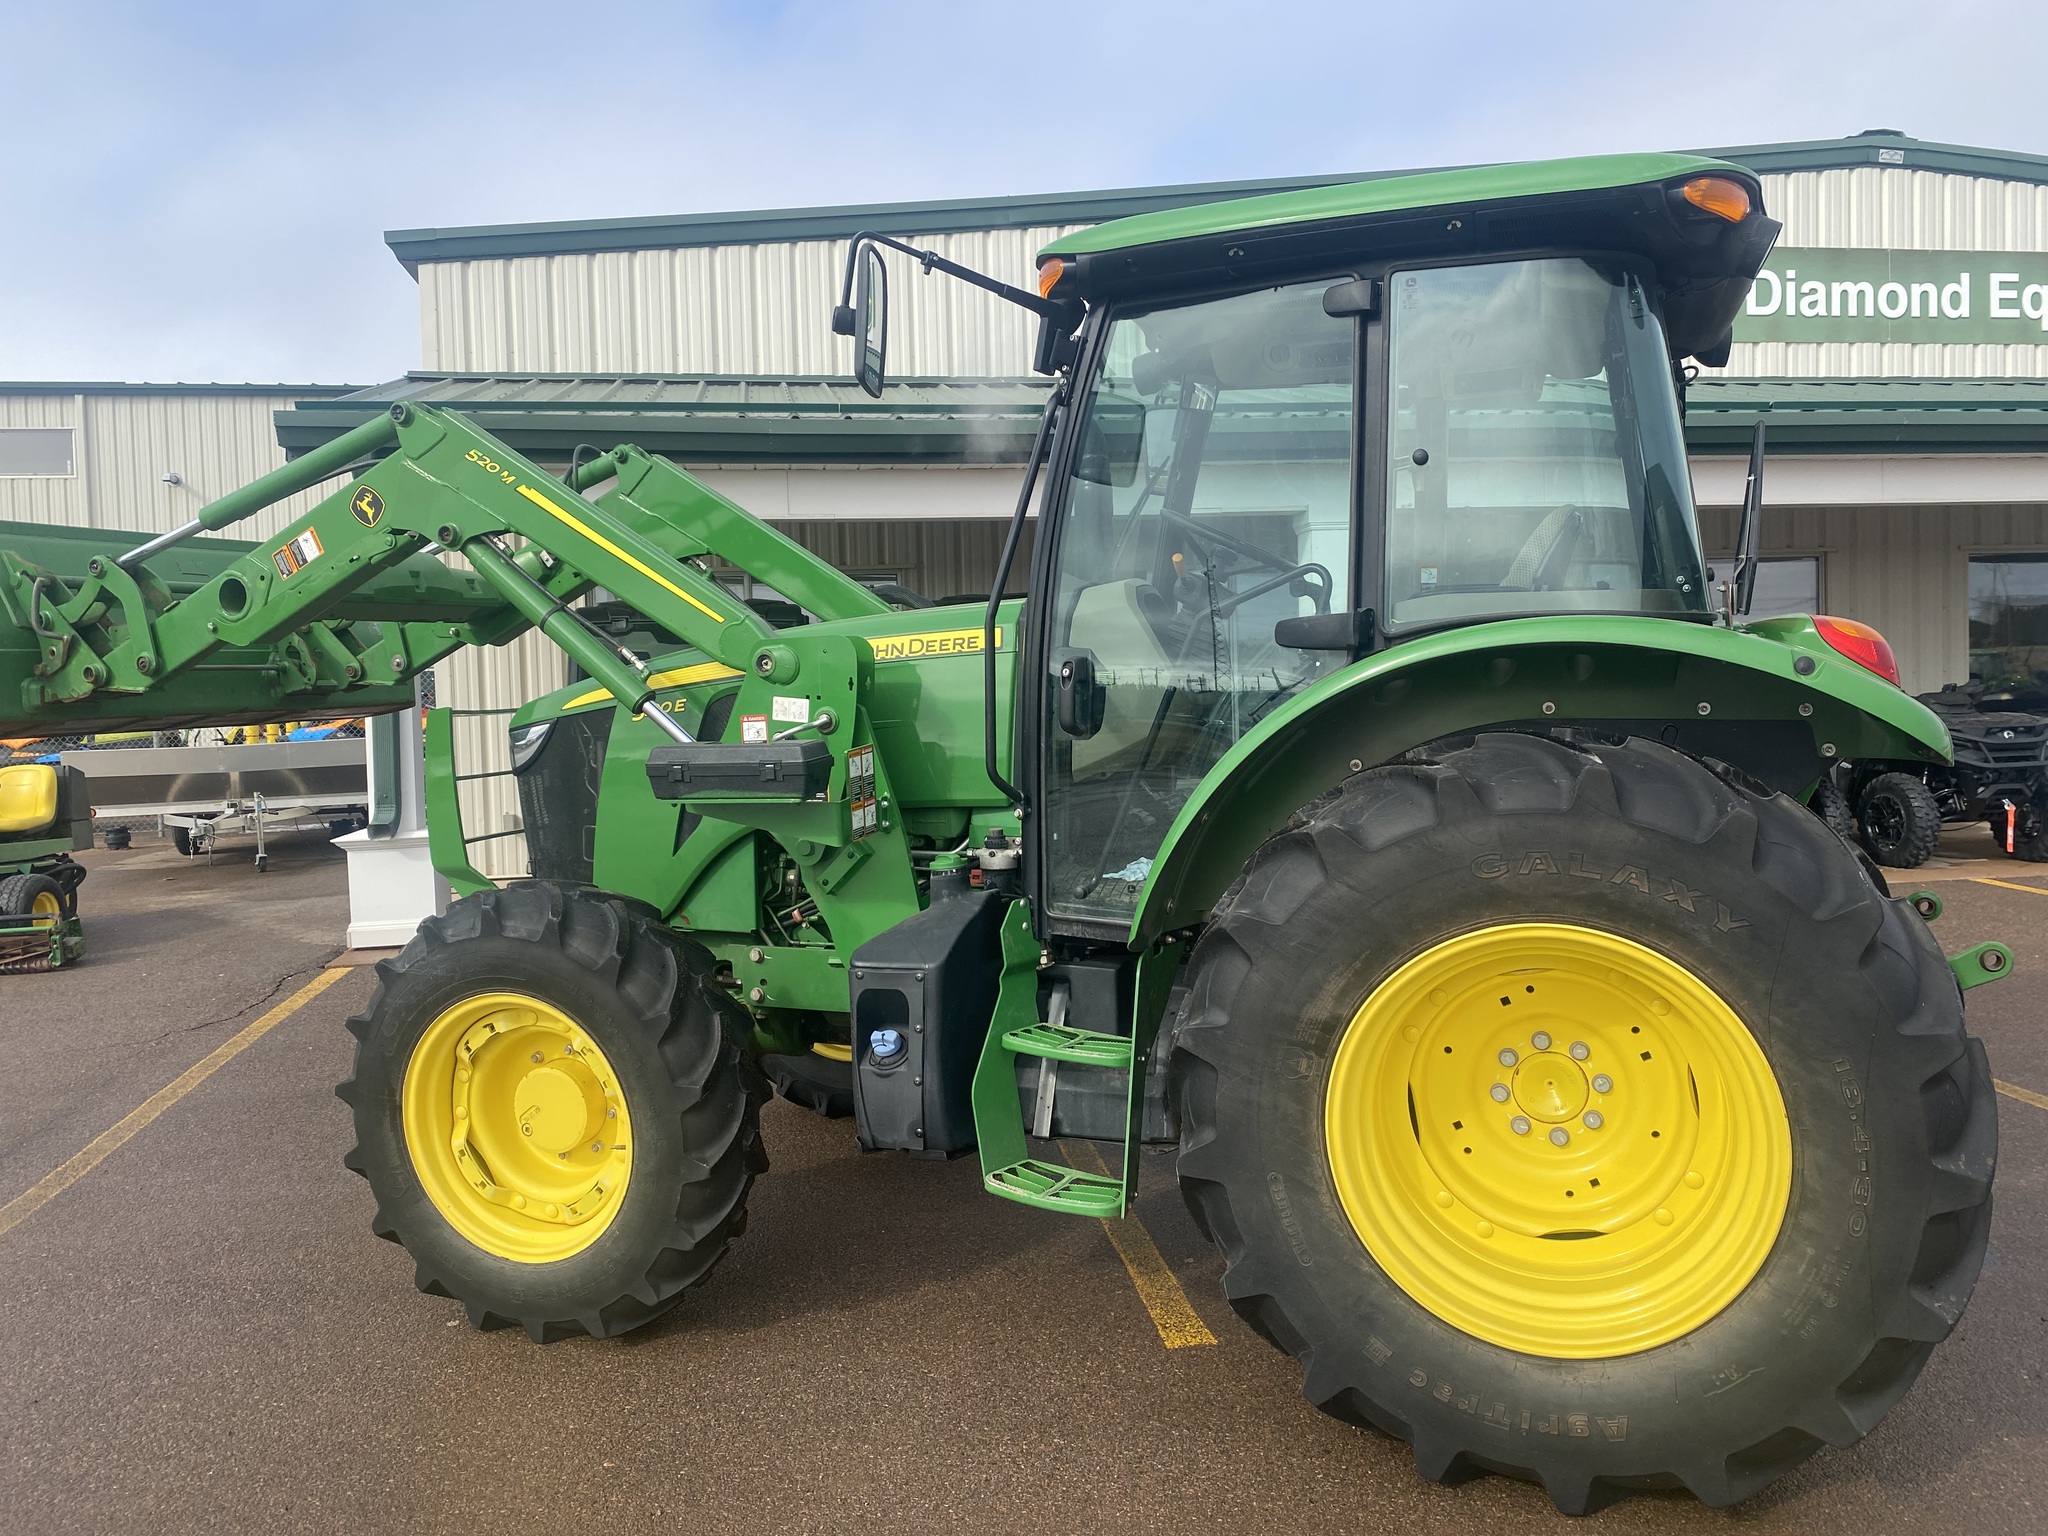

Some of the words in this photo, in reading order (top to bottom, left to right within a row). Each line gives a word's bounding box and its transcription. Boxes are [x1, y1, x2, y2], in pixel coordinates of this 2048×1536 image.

[1745, 268, 1970, 319] Diamond
[1989, 272, 2048, 331] Eq
[875, 642, 905, 658] HN
[908, 635, 980, 655] DEERE
[1470, 851, 1755, 934] GALAXY
[1831, 1057, 1872, 1238] 18.4-30
[1408, 1367, 1629, 1442] AgriTrac
